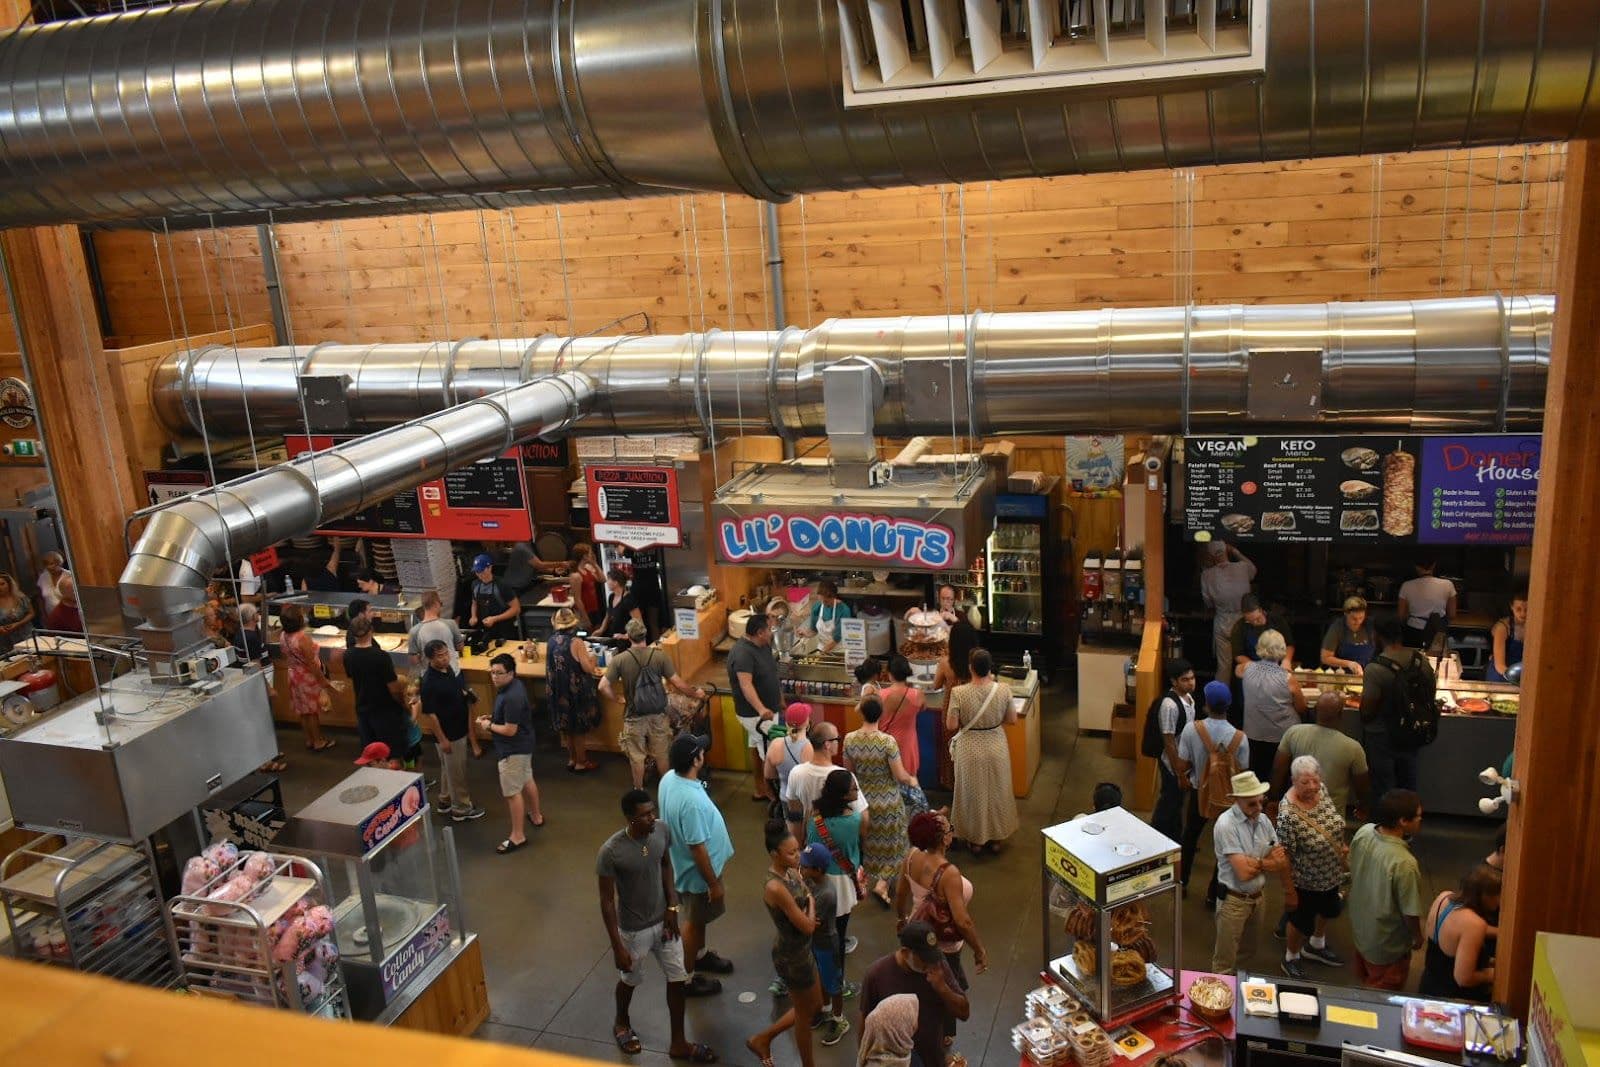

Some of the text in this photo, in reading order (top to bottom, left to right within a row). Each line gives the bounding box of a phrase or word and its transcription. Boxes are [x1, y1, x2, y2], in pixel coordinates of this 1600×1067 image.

[523, 445, 559, 458] NCTION
[1196, 441, 1248, 451] VEGAN
[1280, 440, 1316, 451] KETO
[1443, 444, 1535, 471] Doner
[789, 515, 950, 566] DONUTS
[384, 943, 415, 983] Cotton
[392, 949, 425, 990] Candy
